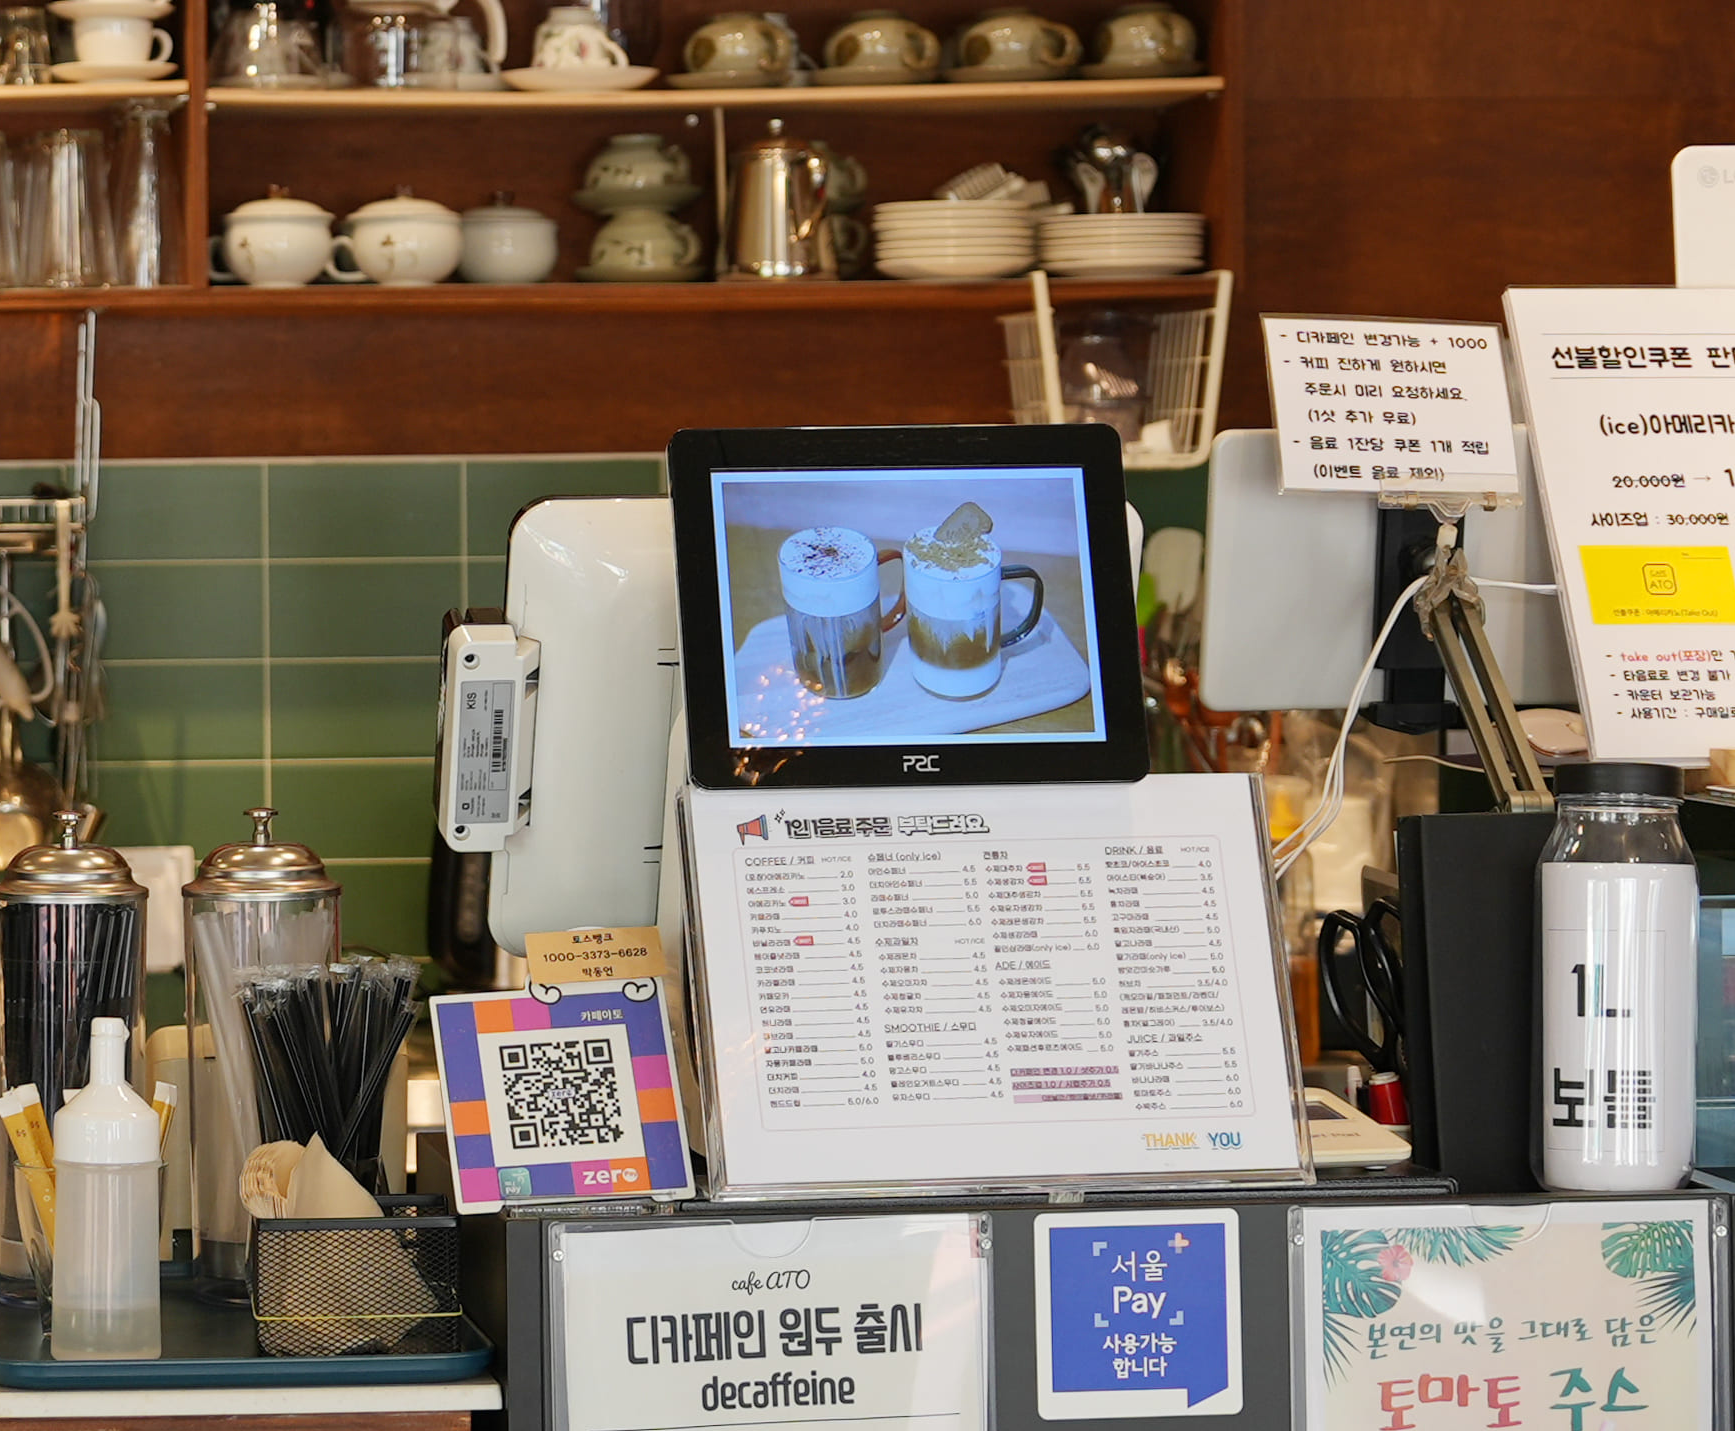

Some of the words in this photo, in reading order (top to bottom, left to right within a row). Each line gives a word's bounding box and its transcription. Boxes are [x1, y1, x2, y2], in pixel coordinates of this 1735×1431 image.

[1297, 331, 1354, 345] 디카페인
[1365, 333, 1420, 348] 변경가능
[1449, 337, 1487, 349] 1000
[1300, 357, 1329, 370] 커피
[1338, 357, 1381, 371] 진하게
[1391, 359, 1446, 374] 원하시면
[1551, 346, 1691, 369] 선불할인쿠폰
[1591, 512, 1648, 527] 사이즈업
[856, 817, 892, 837] 주문
[1105, 845, 1137, 855] DRINK
[745, 856, 787, 866] COFFEE
[884, 1022, 940, 1033] SMOOTHIE
[1128, 1033, 1158, 1043] JUICE
[1142, 1133, 1197, 1148] THANK
[1209, 1132, 1241, 1148] YOU
[1111, 1250, 1168, 1283] 서울
[1113, 1284, 1167, 1320] Pay
[626, 1314, 772, 1366] 디카페인
[778, 1306, 841, 1358] 원두
[853, 1302, 923, 1354] 출시
[1103, 1332, 1177, 1354] 사용가능
[1112, 1356, 1168, 1379] 합니다
[701, 1372, 855, 1411] decaffeine
[1377, 1373, 1523, 1431] 토마토
